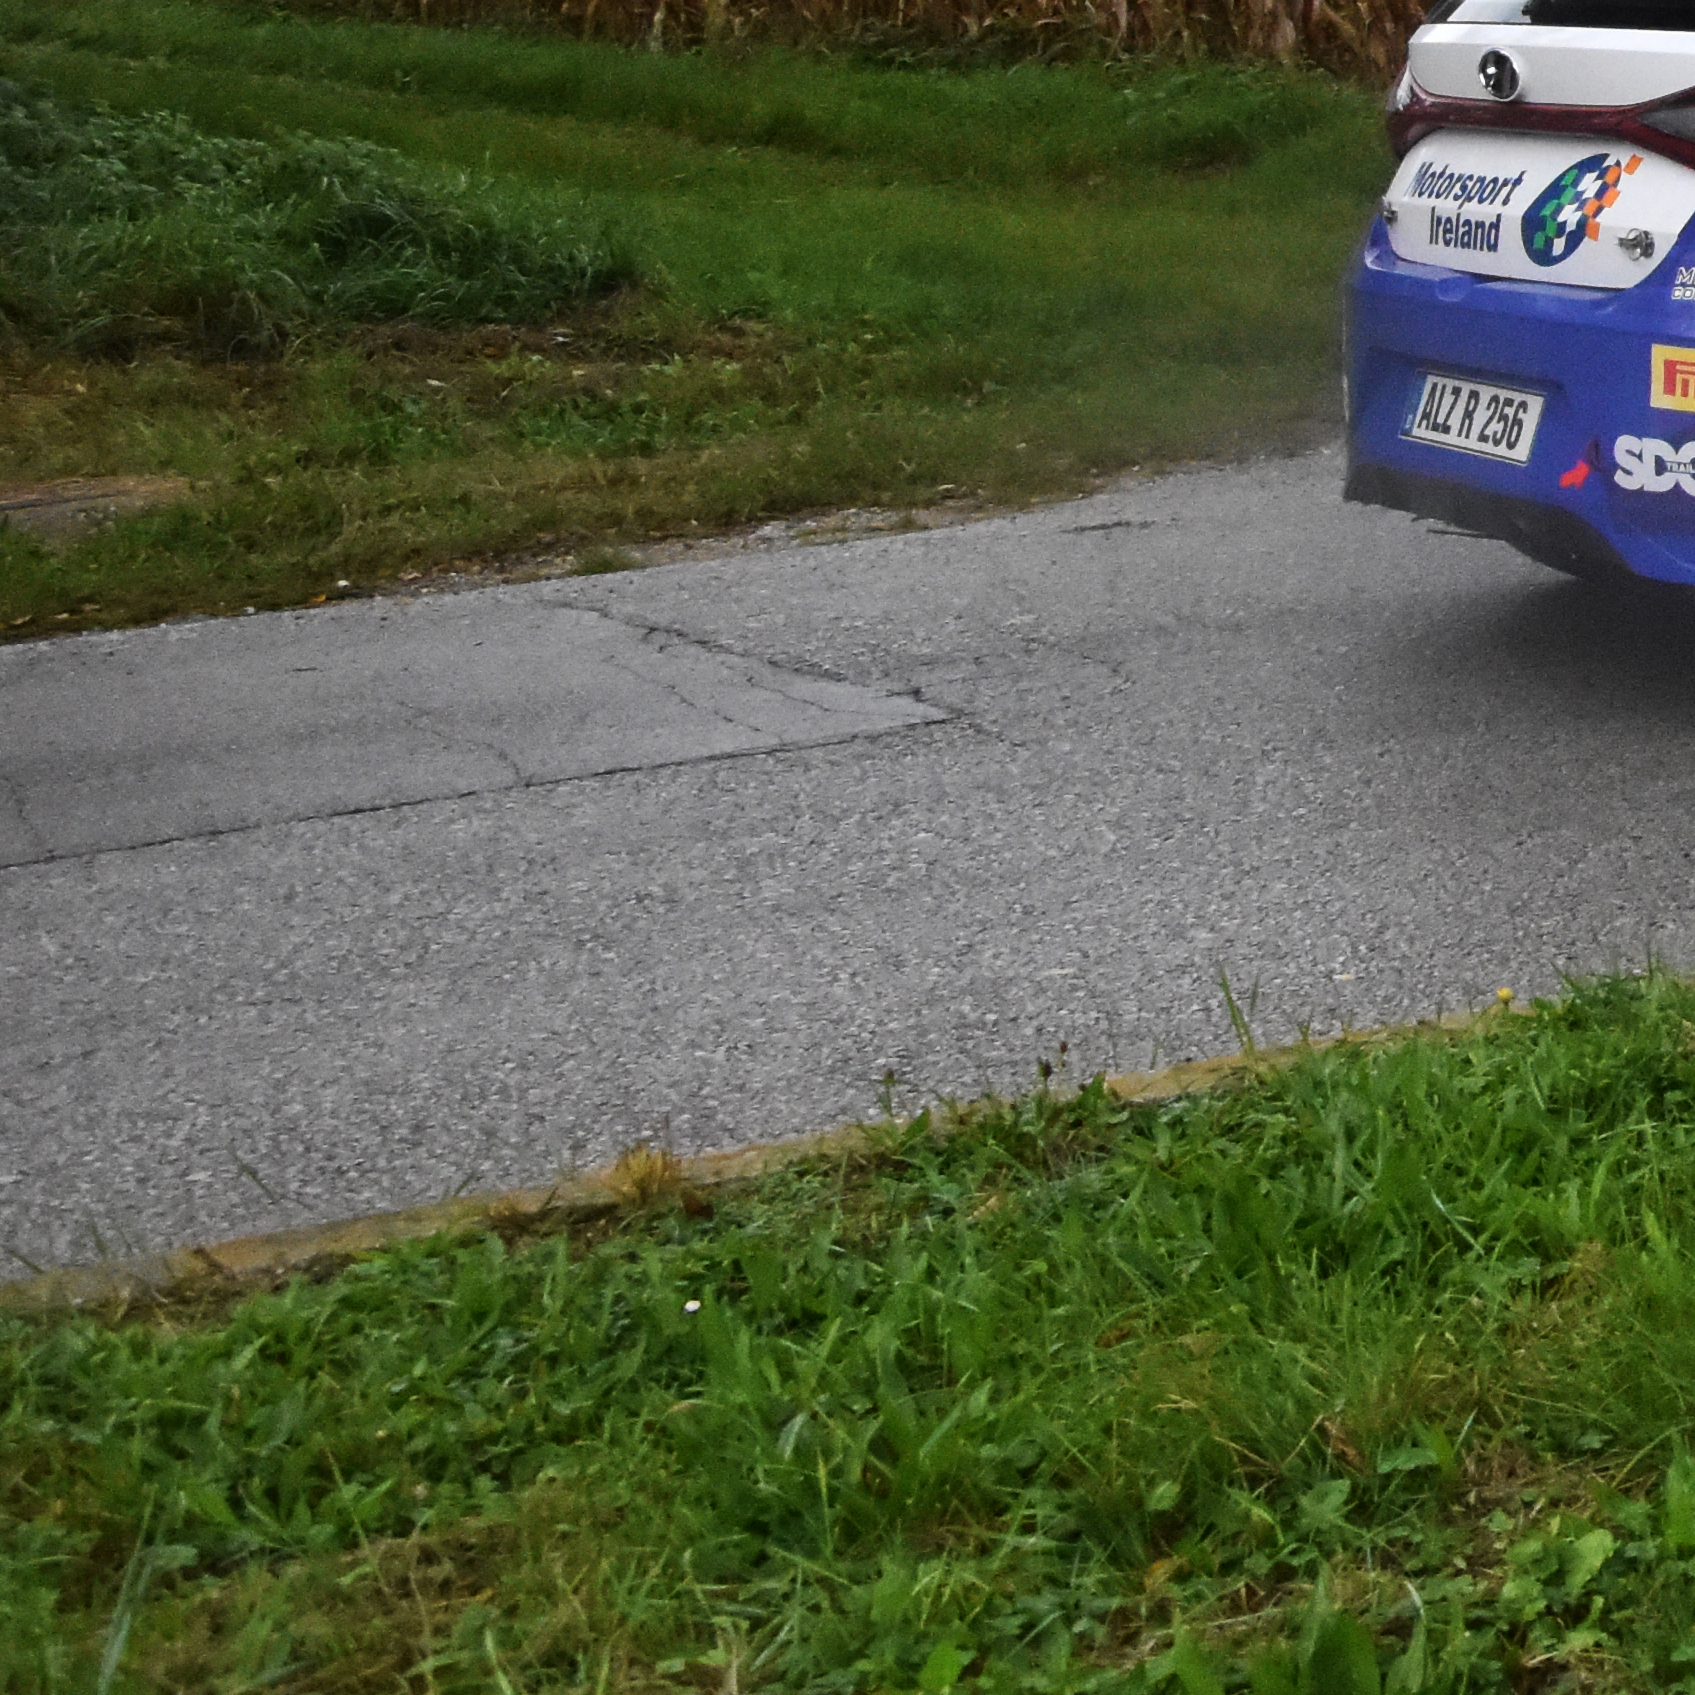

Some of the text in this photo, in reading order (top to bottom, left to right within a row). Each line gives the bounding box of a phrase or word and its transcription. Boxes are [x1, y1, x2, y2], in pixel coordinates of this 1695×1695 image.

[1406, 161, 1527, 210] Motorsport
[1429, 205, 1502, 252] Ireland
[1417, 381, 1528, 451] ALZ R 256
